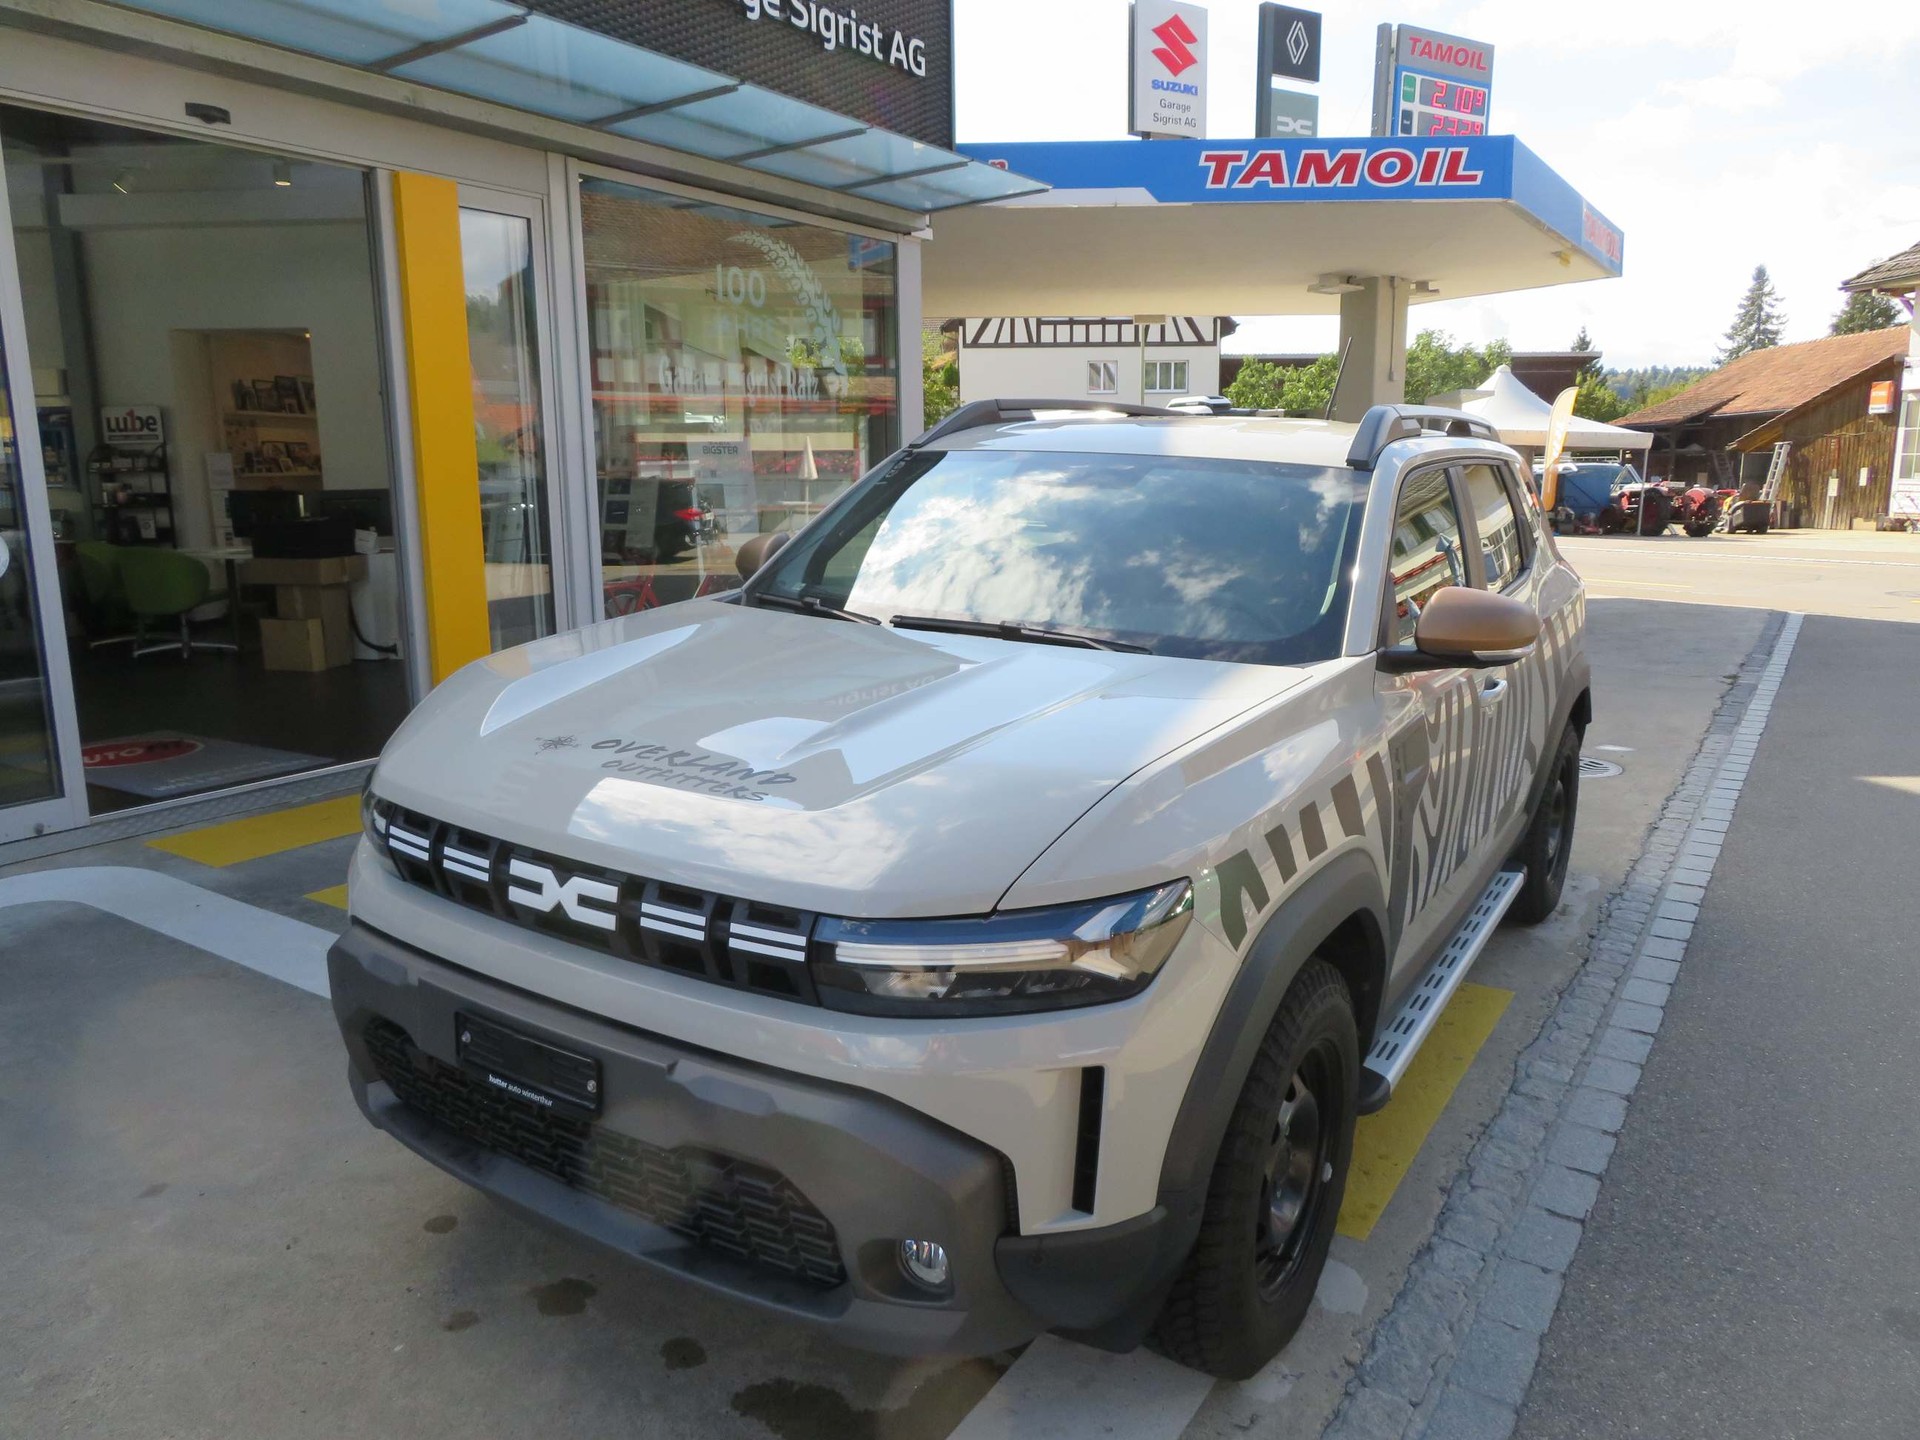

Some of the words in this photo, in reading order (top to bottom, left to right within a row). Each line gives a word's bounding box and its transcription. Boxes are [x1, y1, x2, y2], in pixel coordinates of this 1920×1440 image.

[790, 0, 883, 60] Sigrist
[890, 31, 926, 77] AG
[1409, 36, 1487, 71] TAMOIL
[1151, 79, 1198, 96] SUZUKI
[1153, 113, 1181, 126] Sigrist
[1184, 117, 1197, 128] AG
[1160, 98, 1191, 113] Garage
[1199, 147, 1484, 189] TAMOIL
[716, 263, 766, 308] 100
[702, 445, 738, 455] BIGSTER
[591, 739, 797, 785] OVERLAND
[601, 760, 769, 802] OUTFITTERS
[521, 1088, 553, 1107] winterthur
